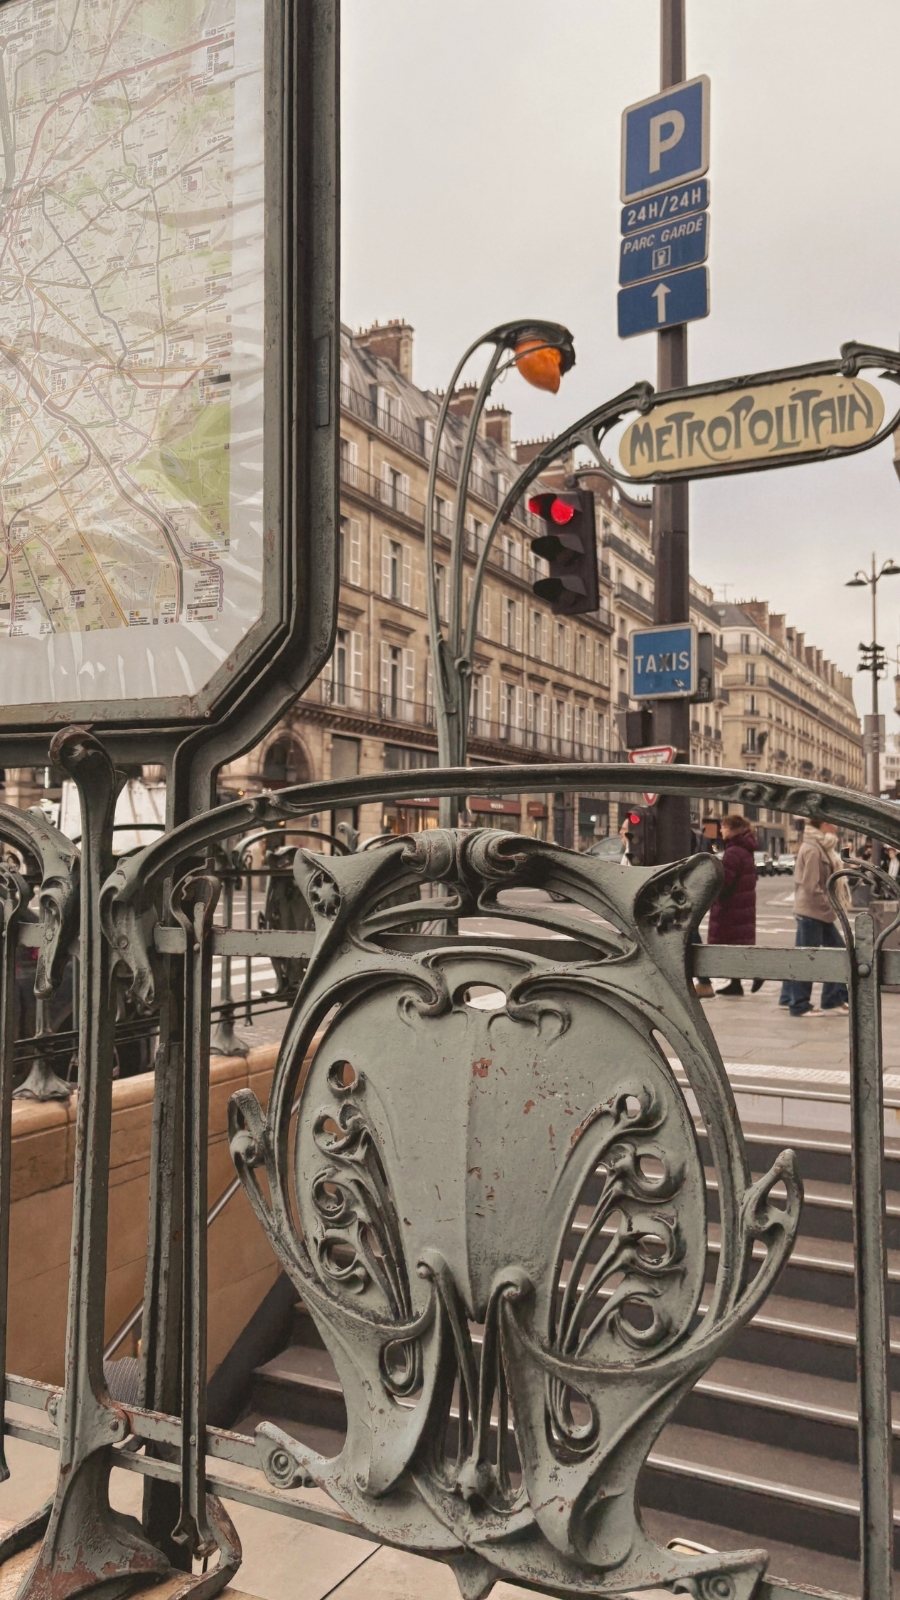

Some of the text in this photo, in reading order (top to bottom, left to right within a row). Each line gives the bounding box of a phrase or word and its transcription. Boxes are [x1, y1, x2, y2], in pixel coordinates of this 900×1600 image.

[649, 109, 686, 174] P
[627, 187, 702, 227] 24H/24H
[623, 215, 704, 255] PARC GARDÉ
[628, 381, 875, 467] METROPOLITAIN
[634, 650, 690, 675] TAXIS
